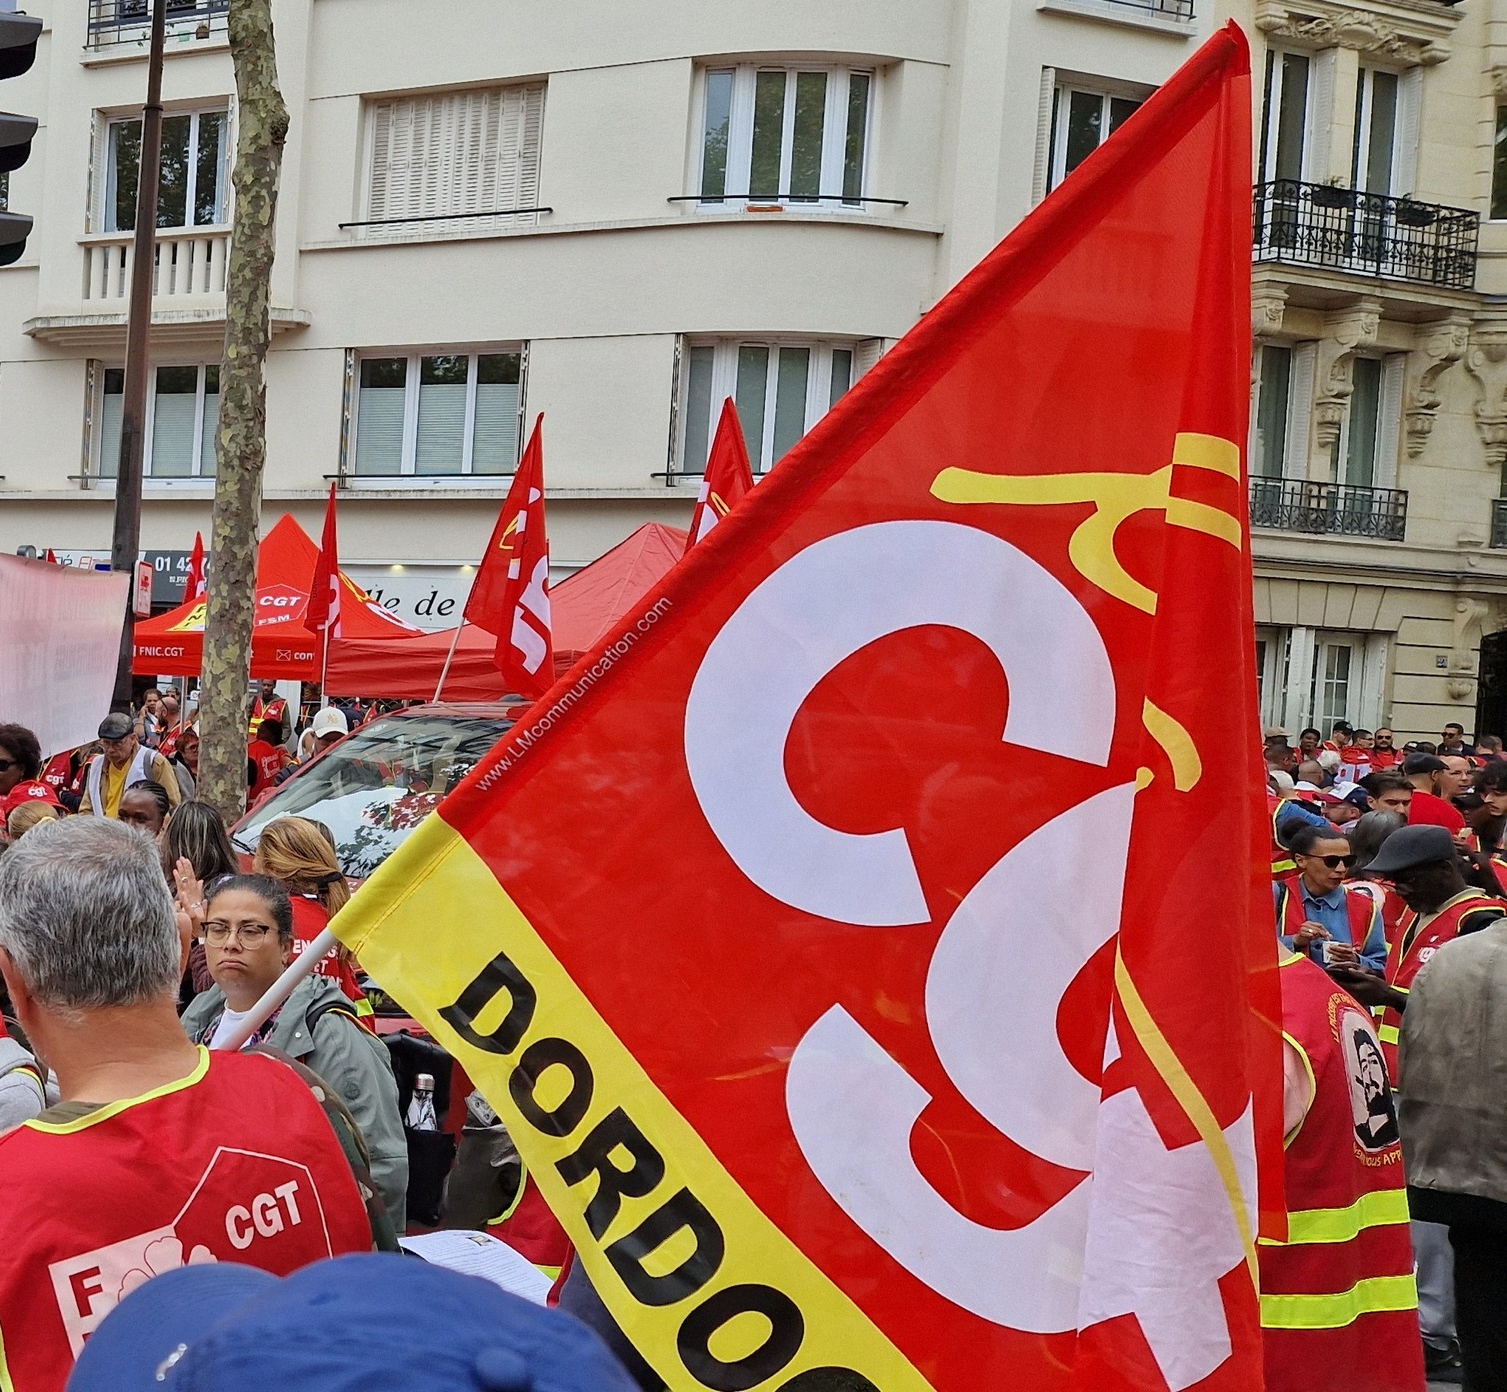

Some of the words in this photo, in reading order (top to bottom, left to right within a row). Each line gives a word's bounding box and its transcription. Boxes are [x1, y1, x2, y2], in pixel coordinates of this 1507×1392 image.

[155, 556, 171, 571] 01
[259, 595, 301, 607] CGT
[414, 590, 455, 616] de
[258, 614, 291, 625] FSM
[139, 646, 185, 657] FNIC.CGT
[475, 596, 673, 793] www.LMcommunication.com
[46, 773, 65, 785] cgt
[28, 785, 48, 798] cgt
[438, 953, 884, 1391] DORDO
[224, 1179, 303, 1250] CGT
